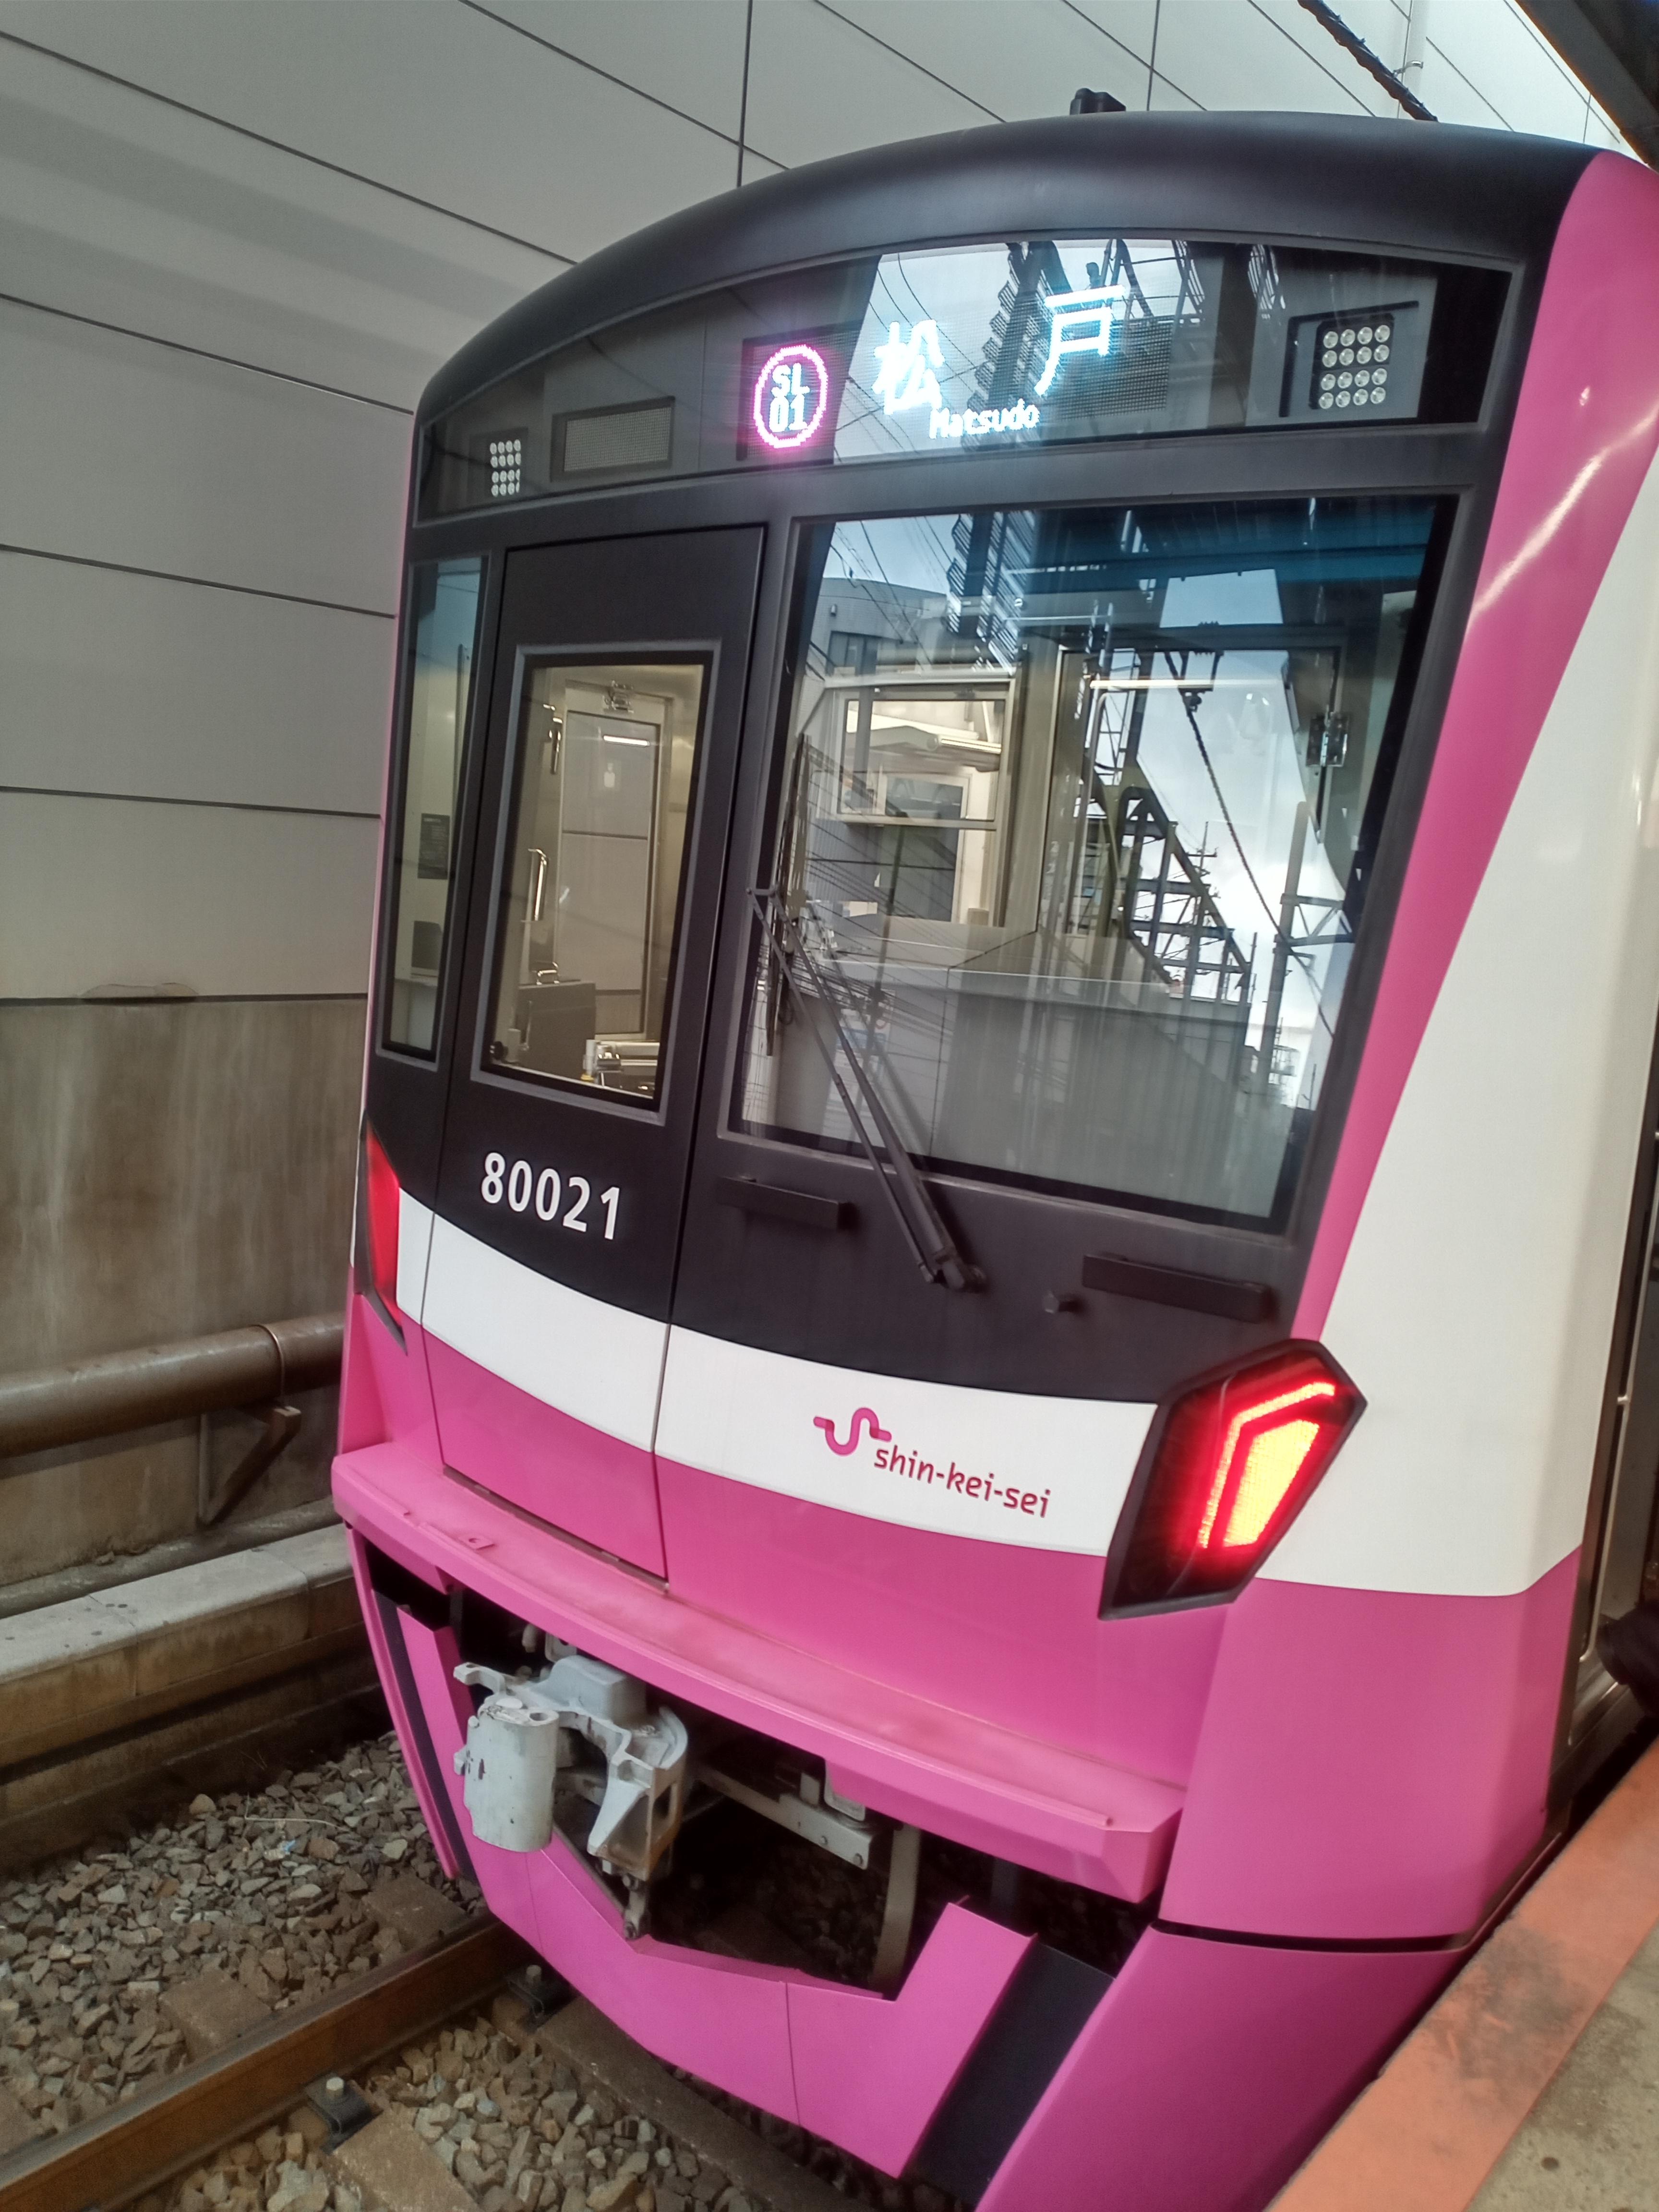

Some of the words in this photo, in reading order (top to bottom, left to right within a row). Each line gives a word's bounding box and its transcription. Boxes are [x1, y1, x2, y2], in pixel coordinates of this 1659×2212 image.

[871, 285, 1126, 415] 松戸
[771, 362, 810, 398] SL
[769, 394, 808, 433] 01
[929, 398, 1041, 439] Matsudo
[481, 1152, 620, 1240] 80021
[874, 1444, 1051, 1518] shin-kei-sei
